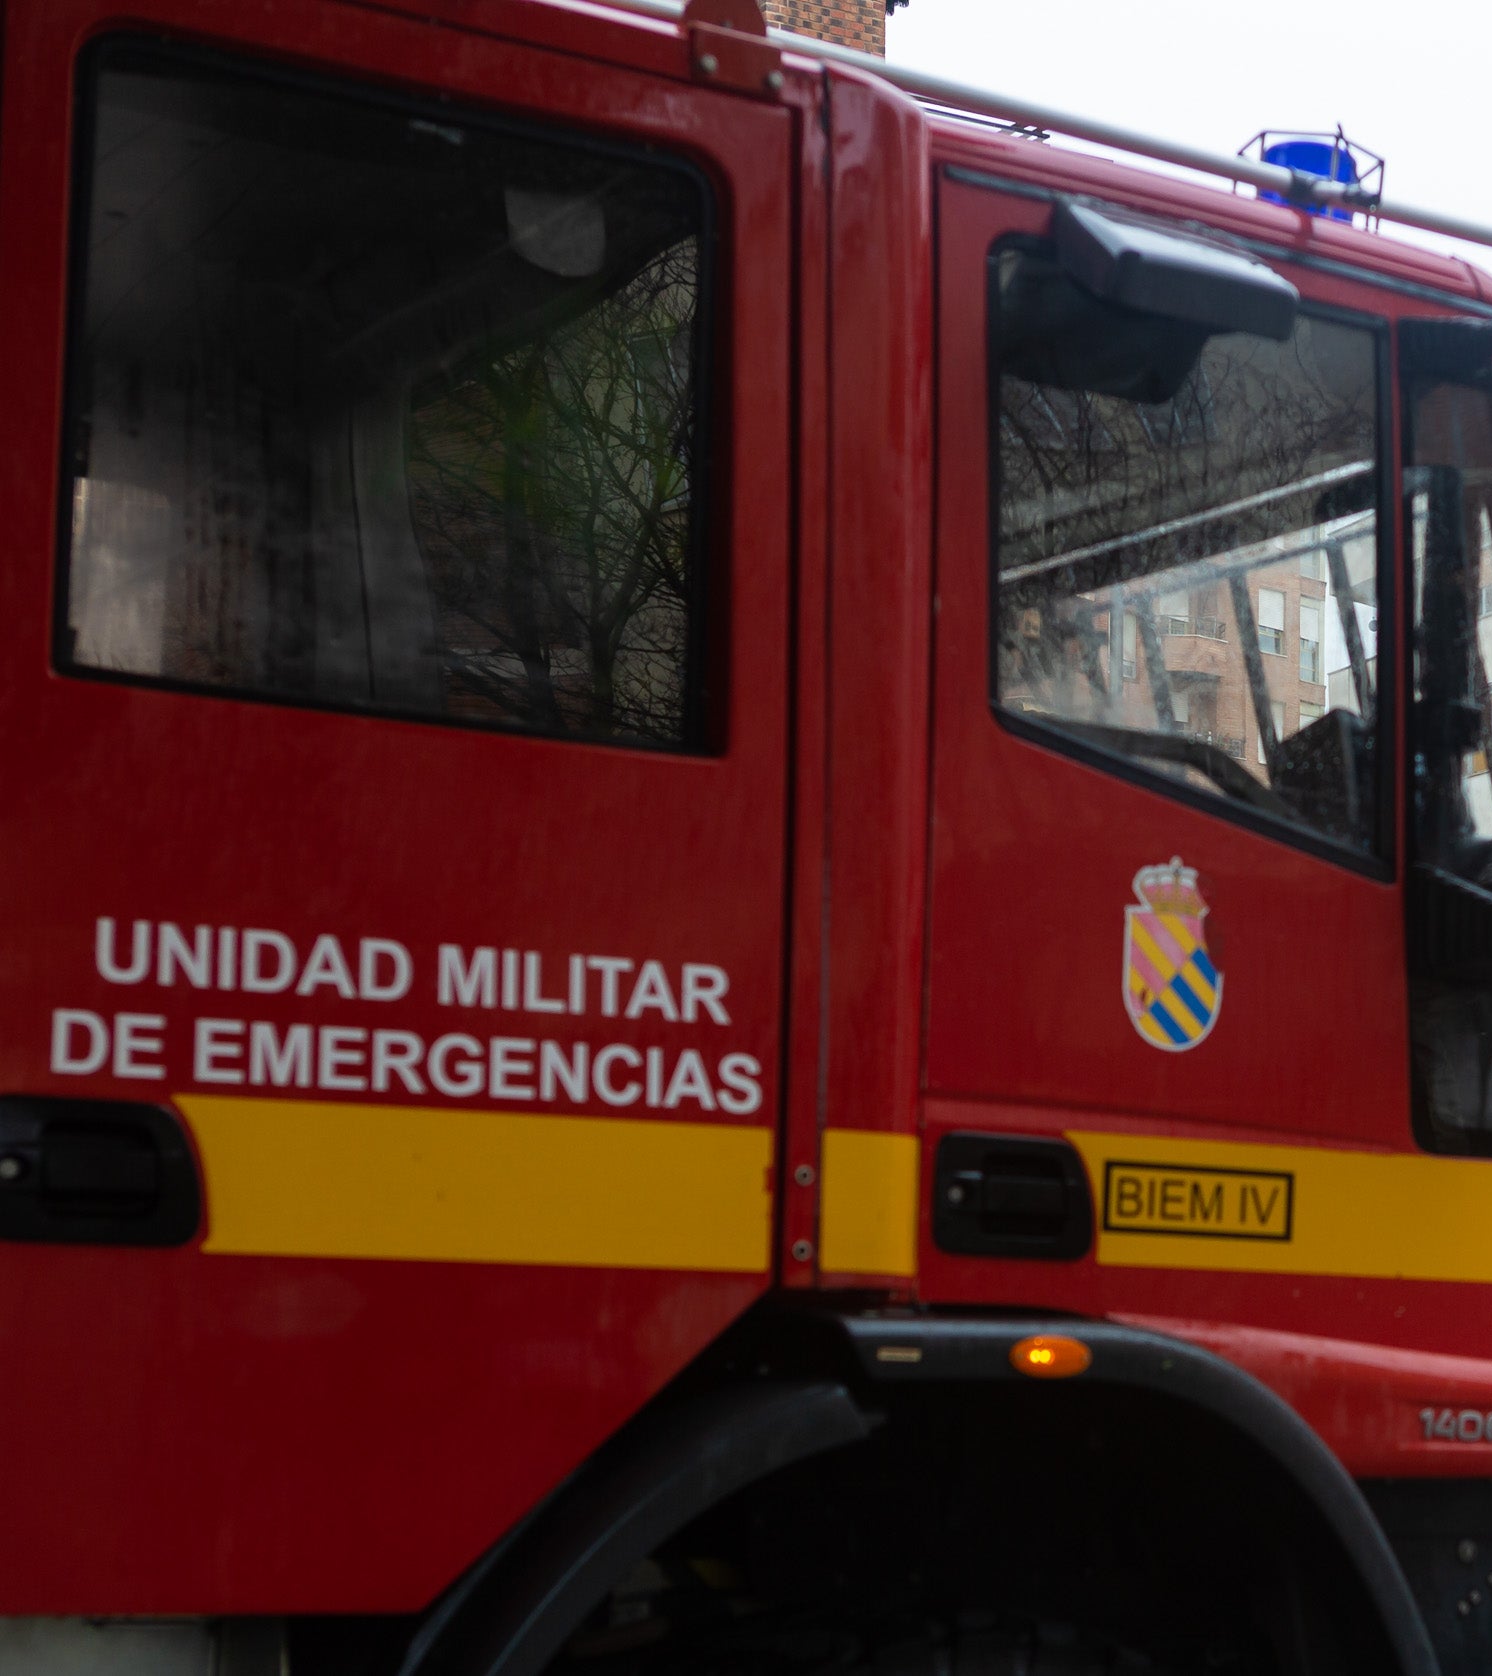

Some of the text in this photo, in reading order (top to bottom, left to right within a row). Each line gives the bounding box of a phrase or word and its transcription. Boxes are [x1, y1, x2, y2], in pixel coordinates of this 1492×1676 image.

[95, 916, 732, 1026] UNIDAD MILITAR
[50, 1009, 763, 1115] DE EMERGENCIAS
[1115, 1176, 1280, 1225] BIEM IV
